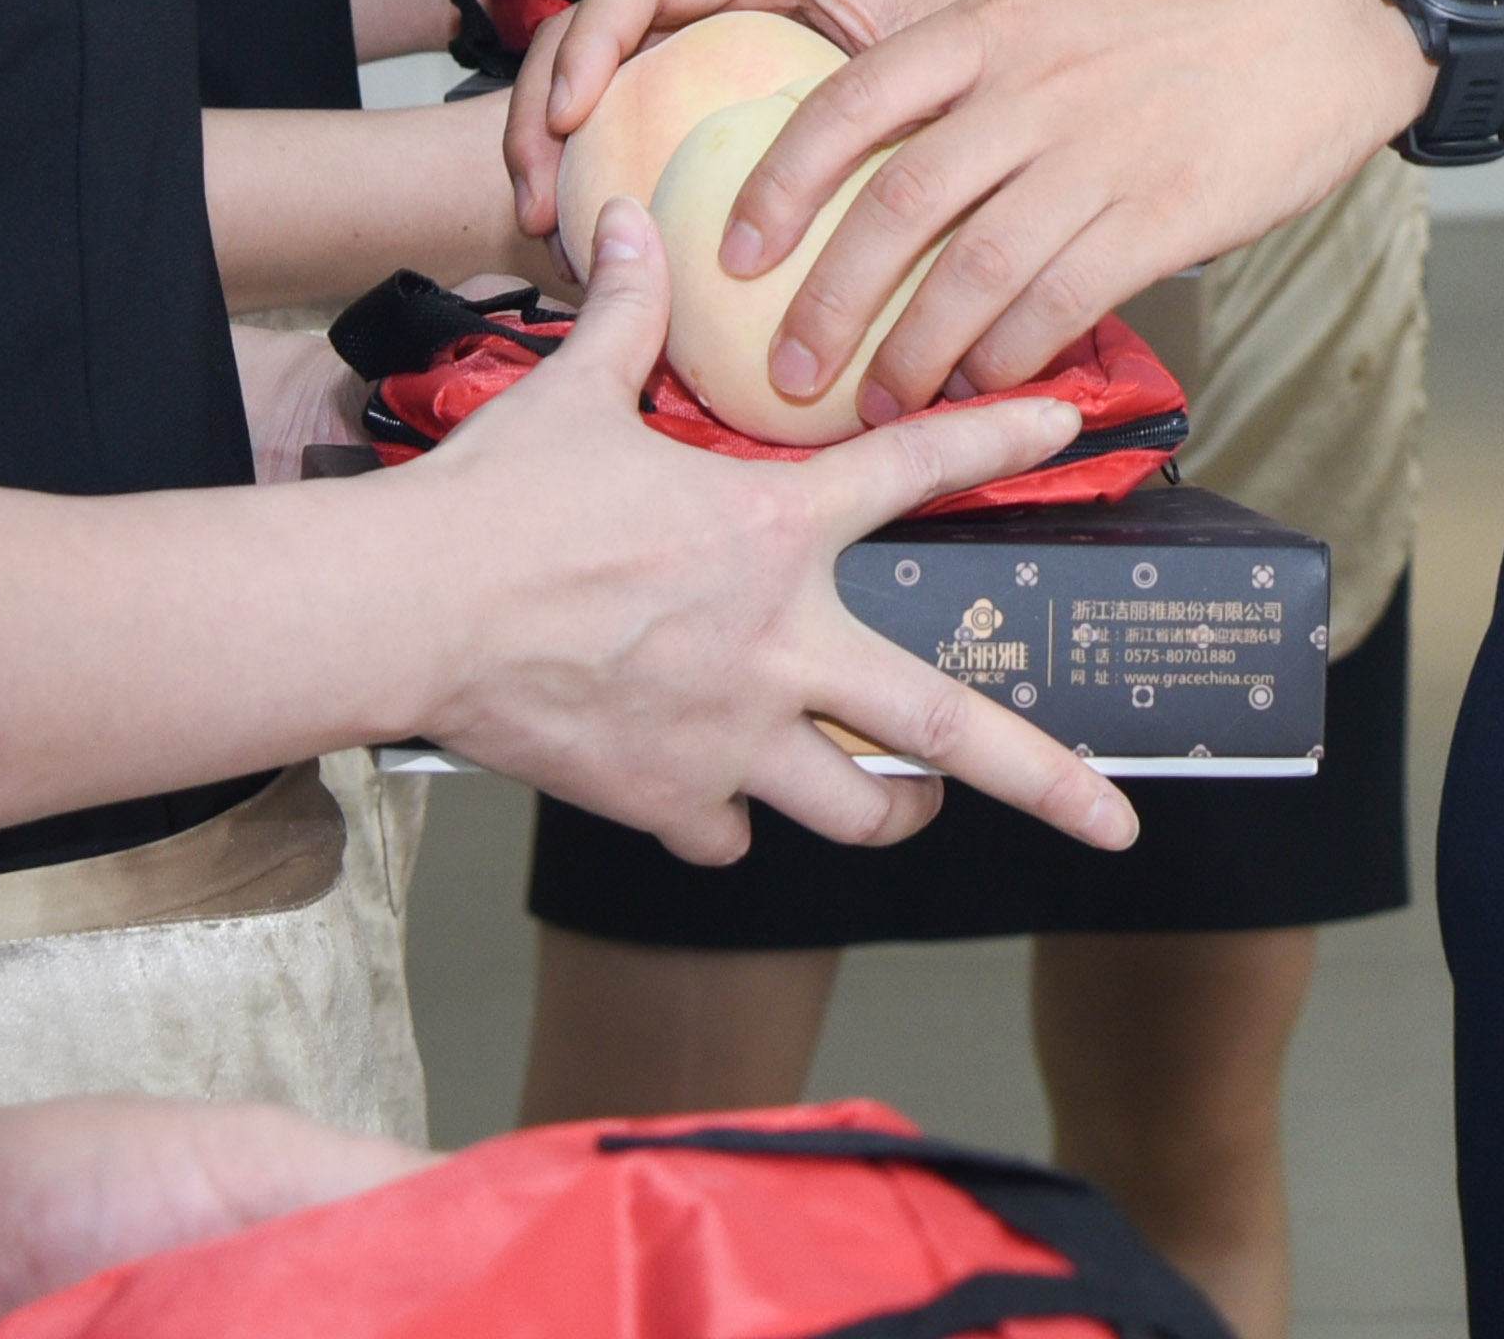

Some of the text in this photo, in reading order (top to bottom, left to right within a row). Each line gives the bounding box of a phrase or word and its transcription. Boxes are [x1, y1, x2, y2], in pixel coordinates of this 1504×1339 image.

[1071, 600, 1282, 622] 浙江洁丽雅股份有限公司
[936, 640, 1030, 670] 洁丽雅
[1125, 650, 1236, 664] 0575-80701880
[1125, 670, 1275, 687] www.gracechina.com
